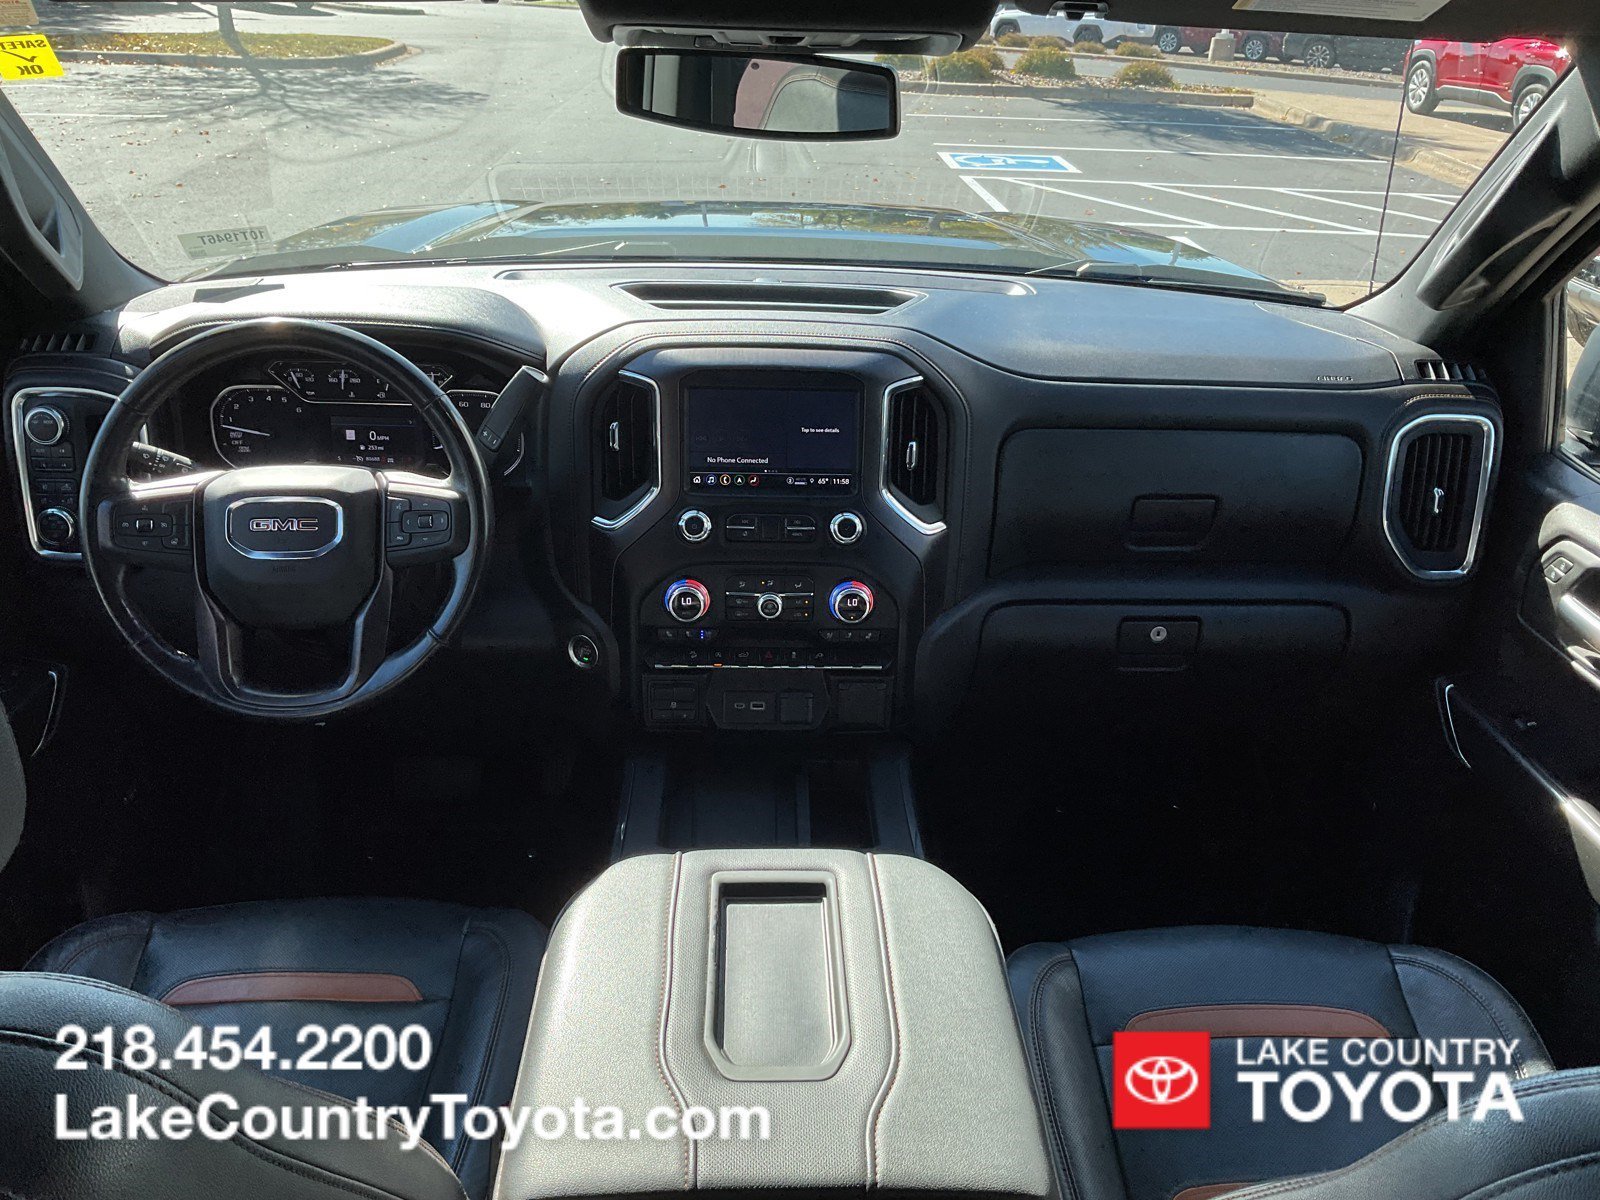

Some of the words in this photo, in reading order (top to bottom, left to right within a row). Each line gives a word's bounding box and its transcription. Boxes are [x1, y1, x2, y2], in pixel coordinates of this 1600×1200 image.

[369, 430, 377, 441] 0
[249, 517, 319, 532] GMC
[681, 597, 692, 606] LO
[847, 598, 858, 607] LO
